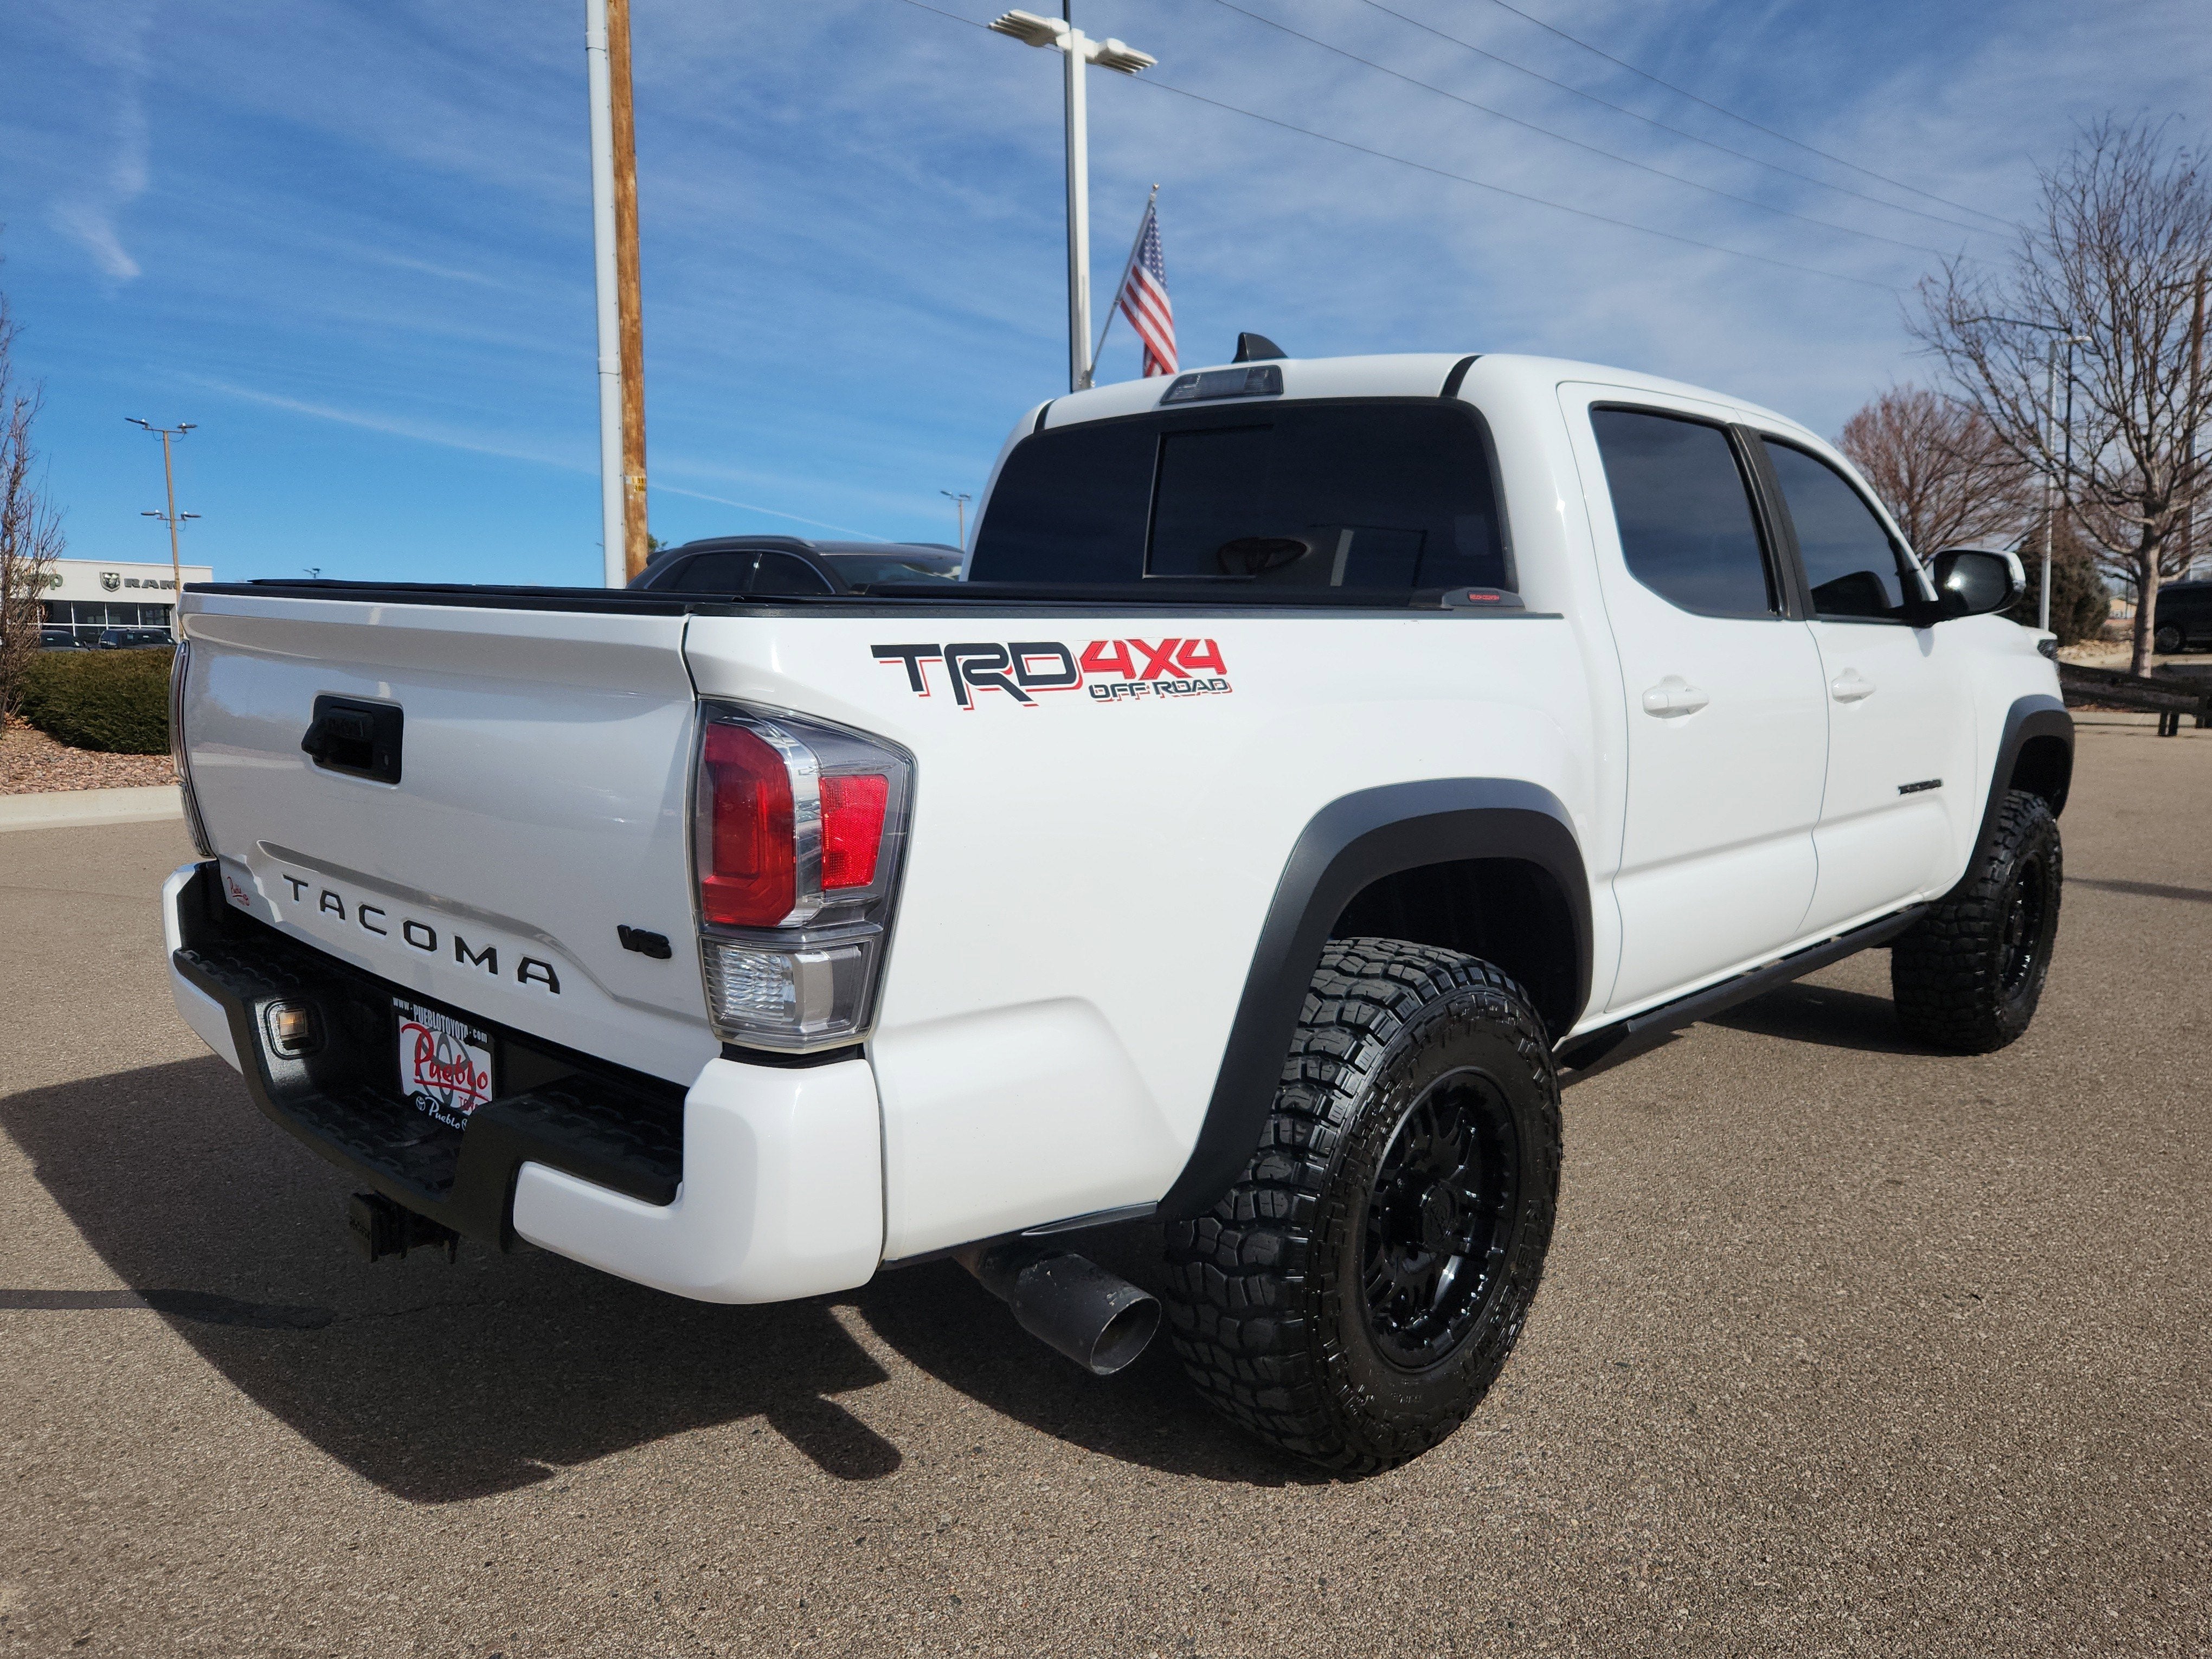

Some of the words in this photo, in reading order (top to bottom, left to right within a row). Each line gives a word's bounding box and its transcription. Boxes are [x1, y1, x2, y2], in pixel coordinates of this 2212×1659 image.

[124, 578, 176, 590] RAM
[870, 641, 1083, 711] TRD
[1079, 639, 1228, 680] 4X4
[1088, 684, 1149, 703] OFF
[1154, 678, 1232, 698] ROAD
[282, 874, 561, 995] TACOMA
[617, 924, 672, 959] V6
[401, 1023, 488, 1090] Pueblo
[425, 1096, 460, 1129] Pueblo
